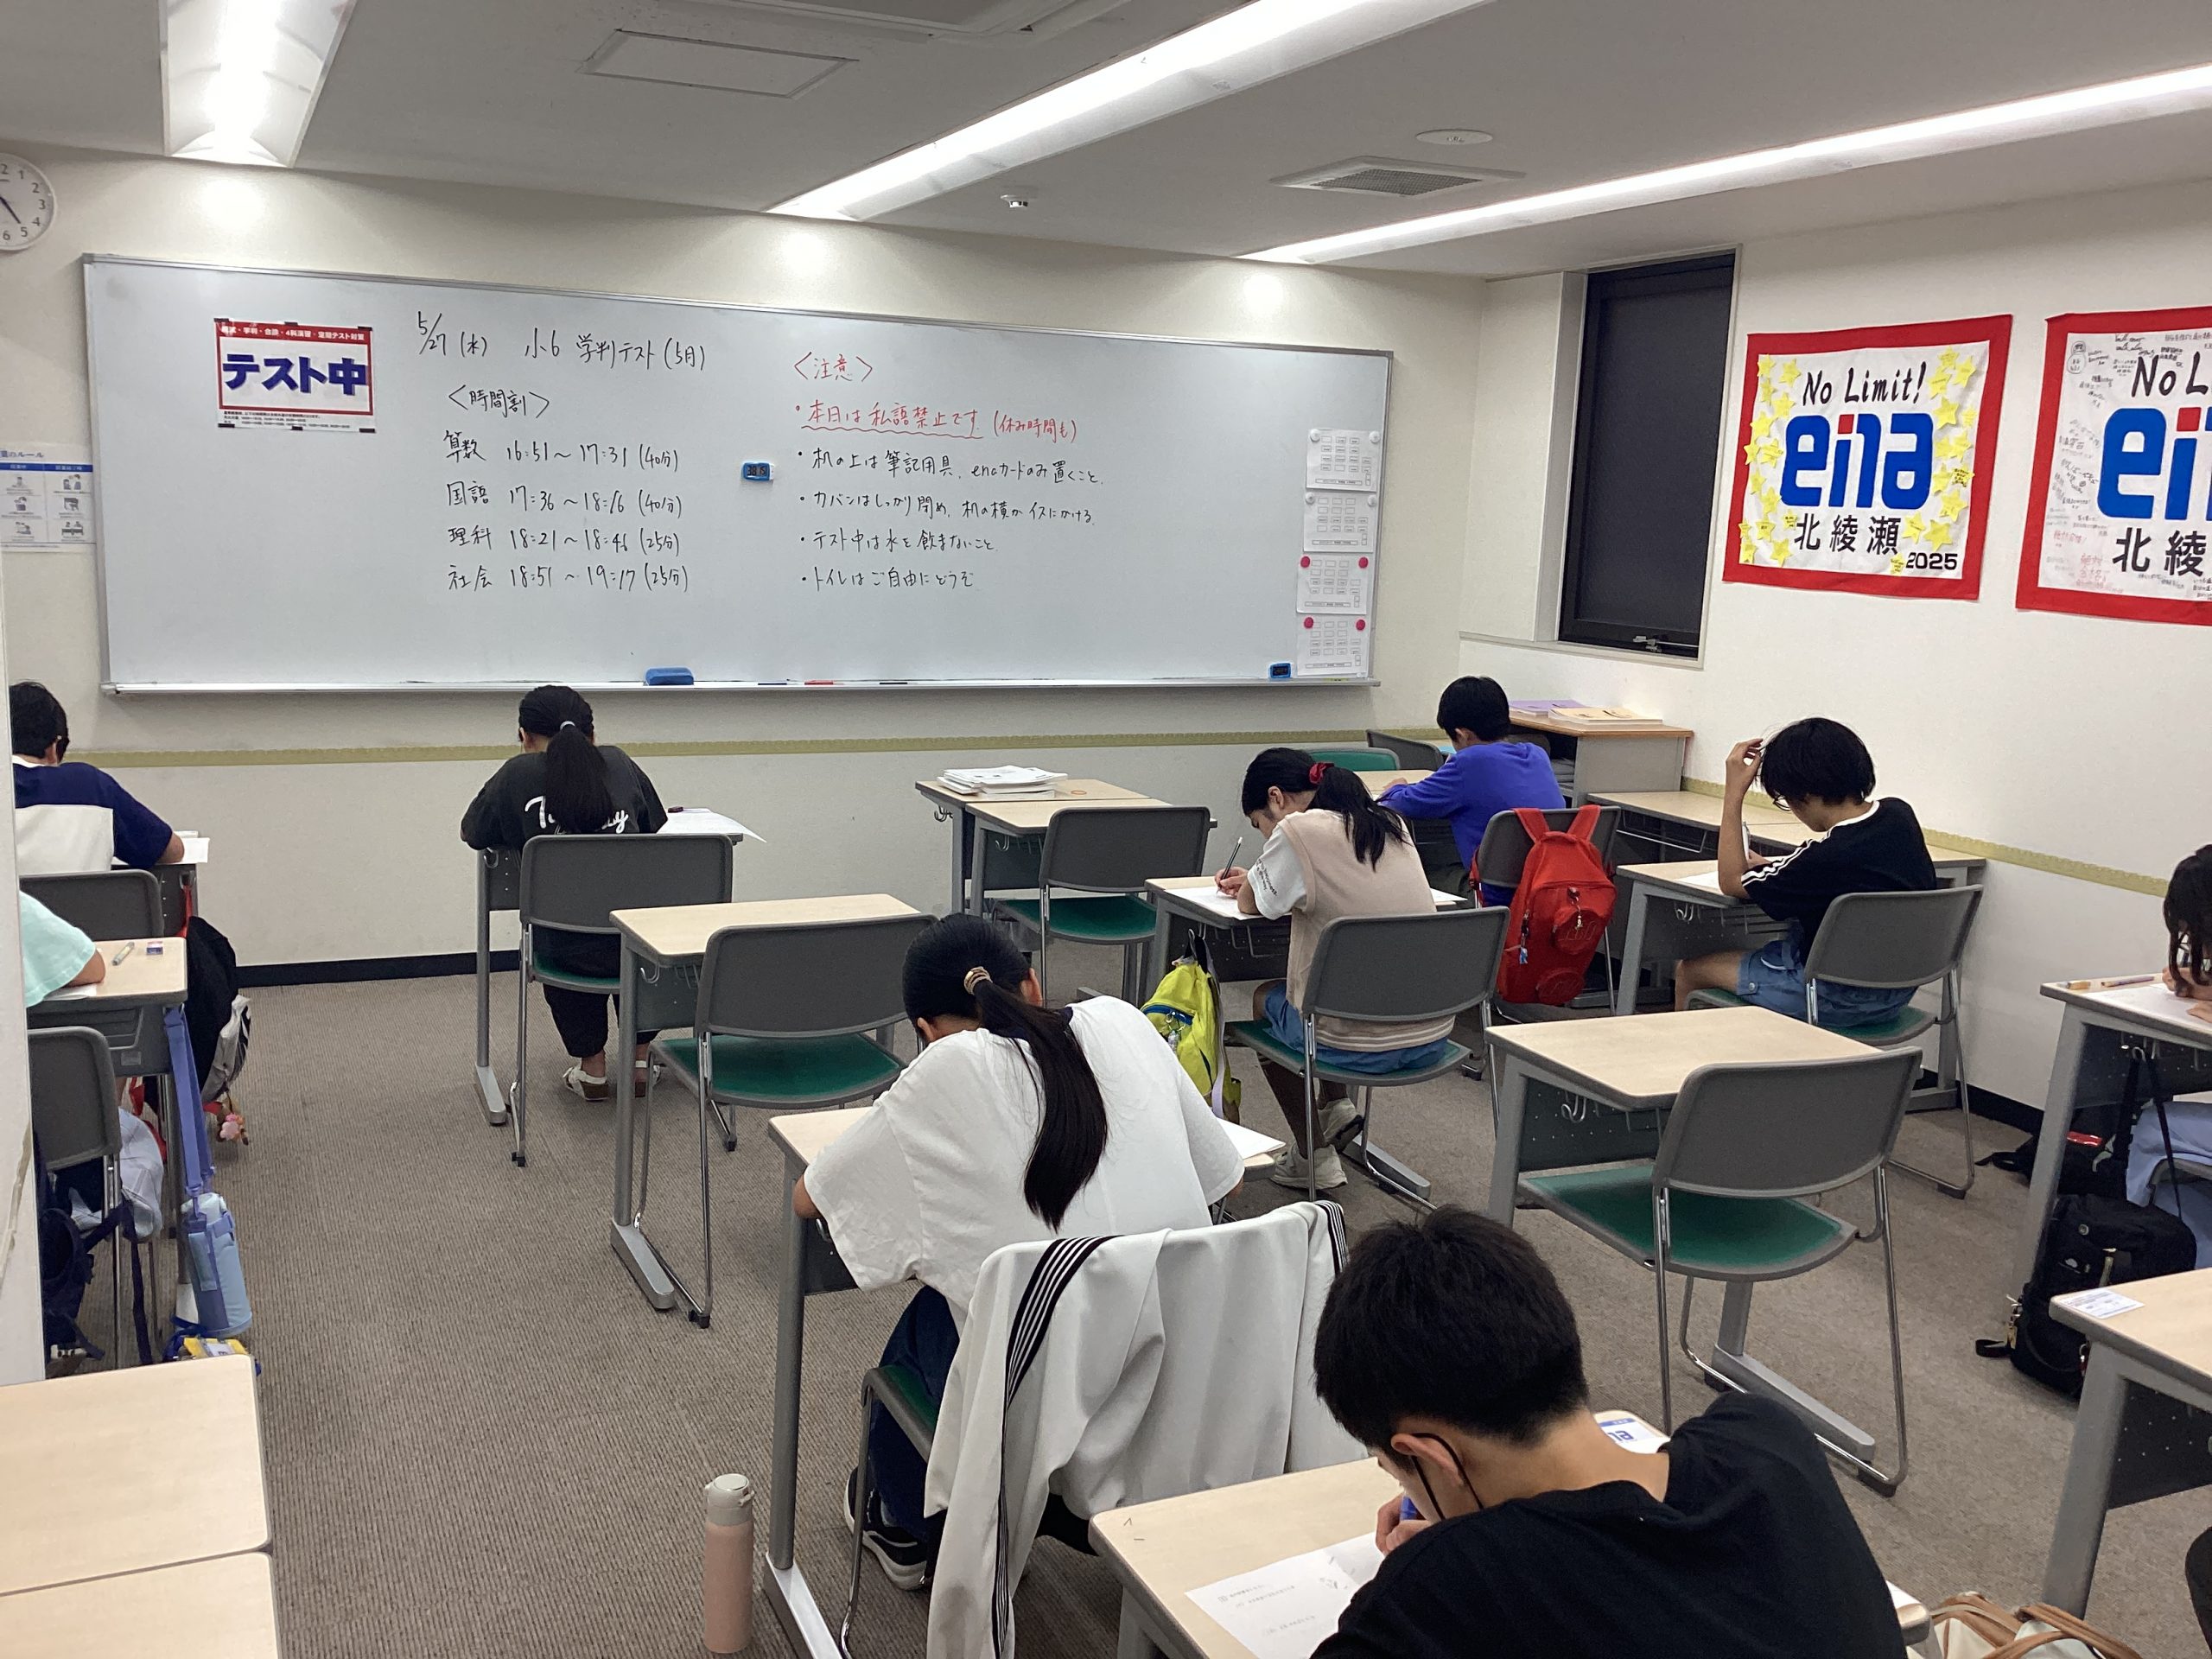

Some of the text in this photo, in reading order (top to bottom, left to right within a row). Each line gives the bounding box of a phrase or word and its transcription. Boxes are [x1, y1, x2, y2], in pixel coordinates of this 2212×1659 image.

[19, 169, 24, 180] 1
[31, 181, 40, 194] 2
[38, 198, 47, 210] 3
[20, 226, 29, 238] 5
[31, 217, 41, 226] 4
[3, 230, 10, 241] 6
[417, 311, 446, 355] 5/27
[222, 353, 369, 396] テスト中
[1802, 361, 1927, 406] No Limit!
[2132, 355, 2177, 397] No
[2185, 351, 2209, 396] L
[443, 429, 486, 463] 算数
[447, 480, 489, 506] 国語
[448, 524, 492, 550] 理科
[1794, 512, 1901, 556] 北綾瀬
[1905, 551, 1958, 570] 2025
[2113, 526, 2208, 576] 北綾
[448, 564, 493, 592] 社会
